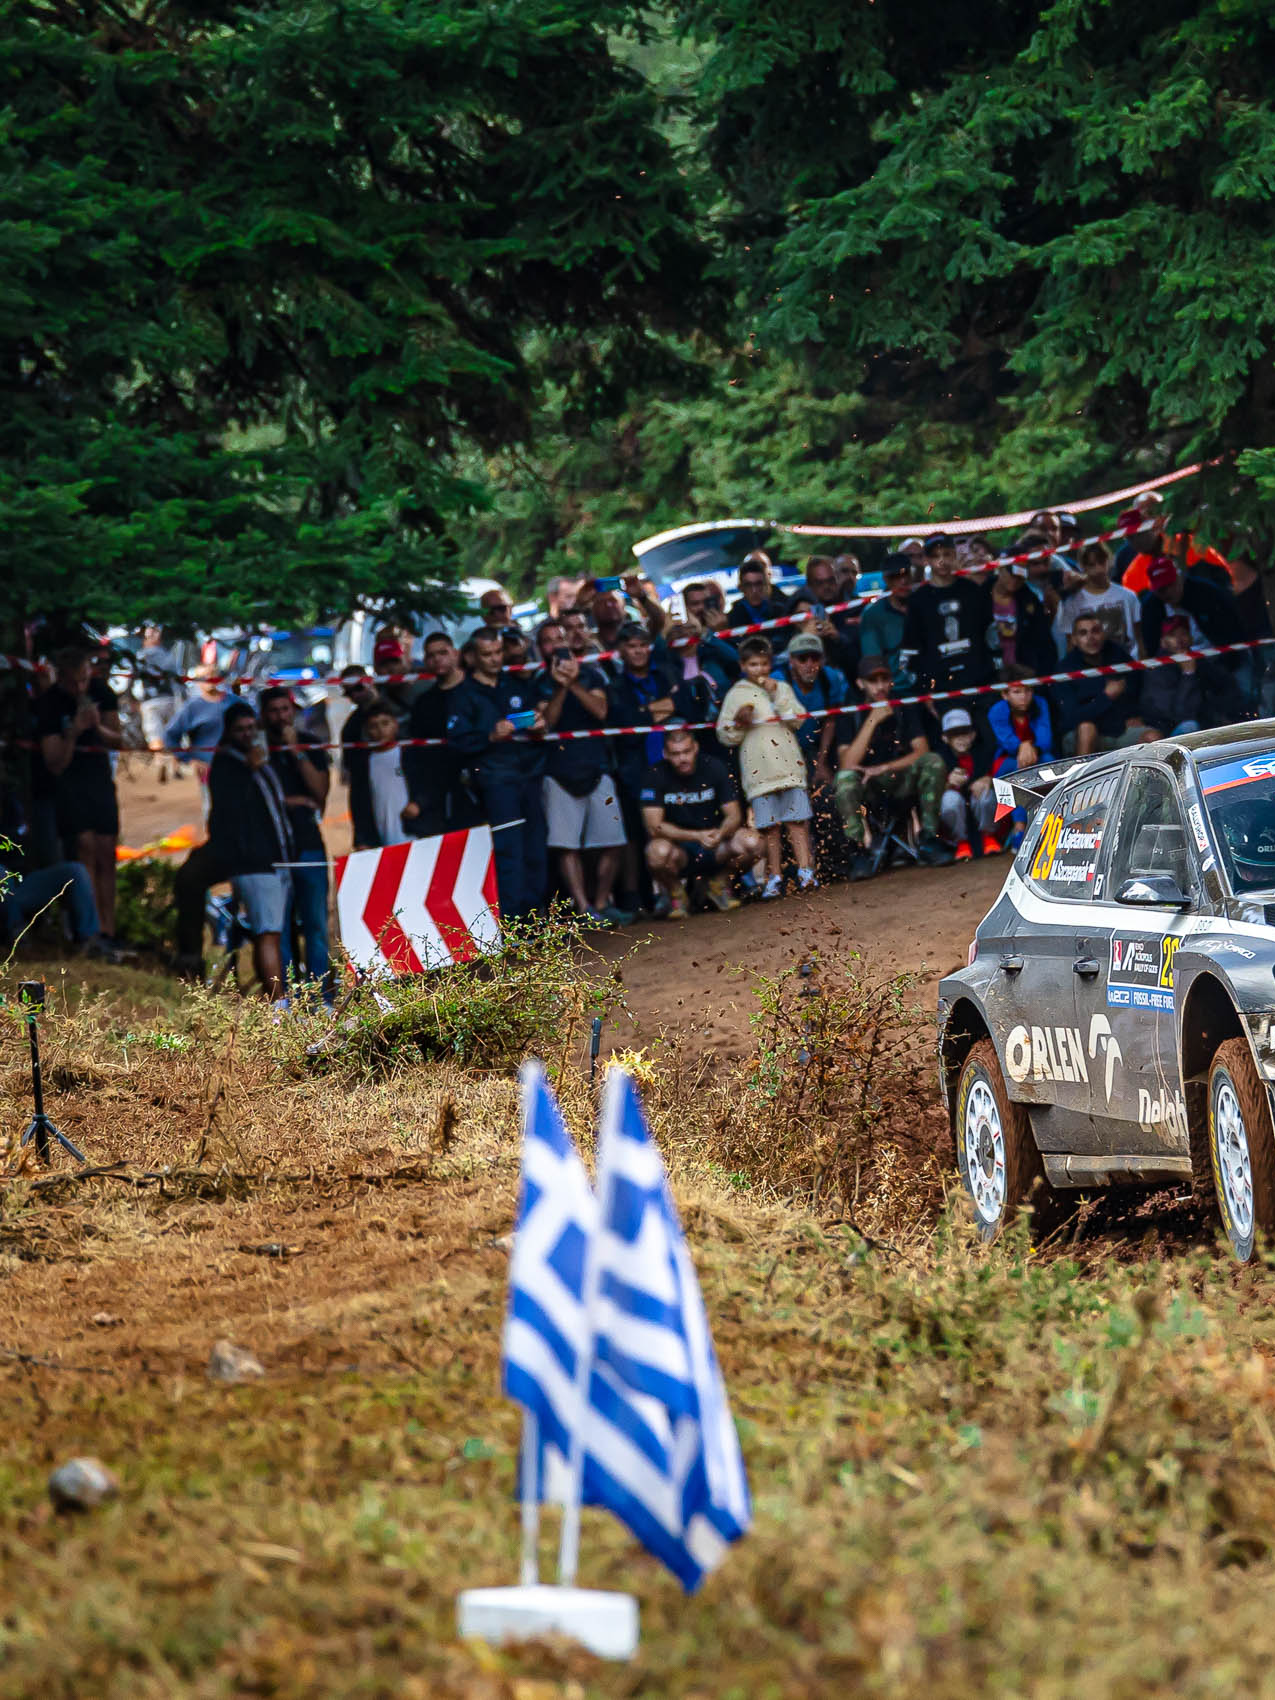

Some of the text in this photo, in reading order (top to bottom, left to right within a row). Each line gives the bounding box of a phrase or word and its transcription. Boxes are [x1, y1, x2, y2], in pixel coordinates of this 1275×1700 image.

[1031, 813, 1064, 880] 29
[1005, 1025, 1089, 1083] ORLEN
[1138, 1088, 1191, 1145] Delph
